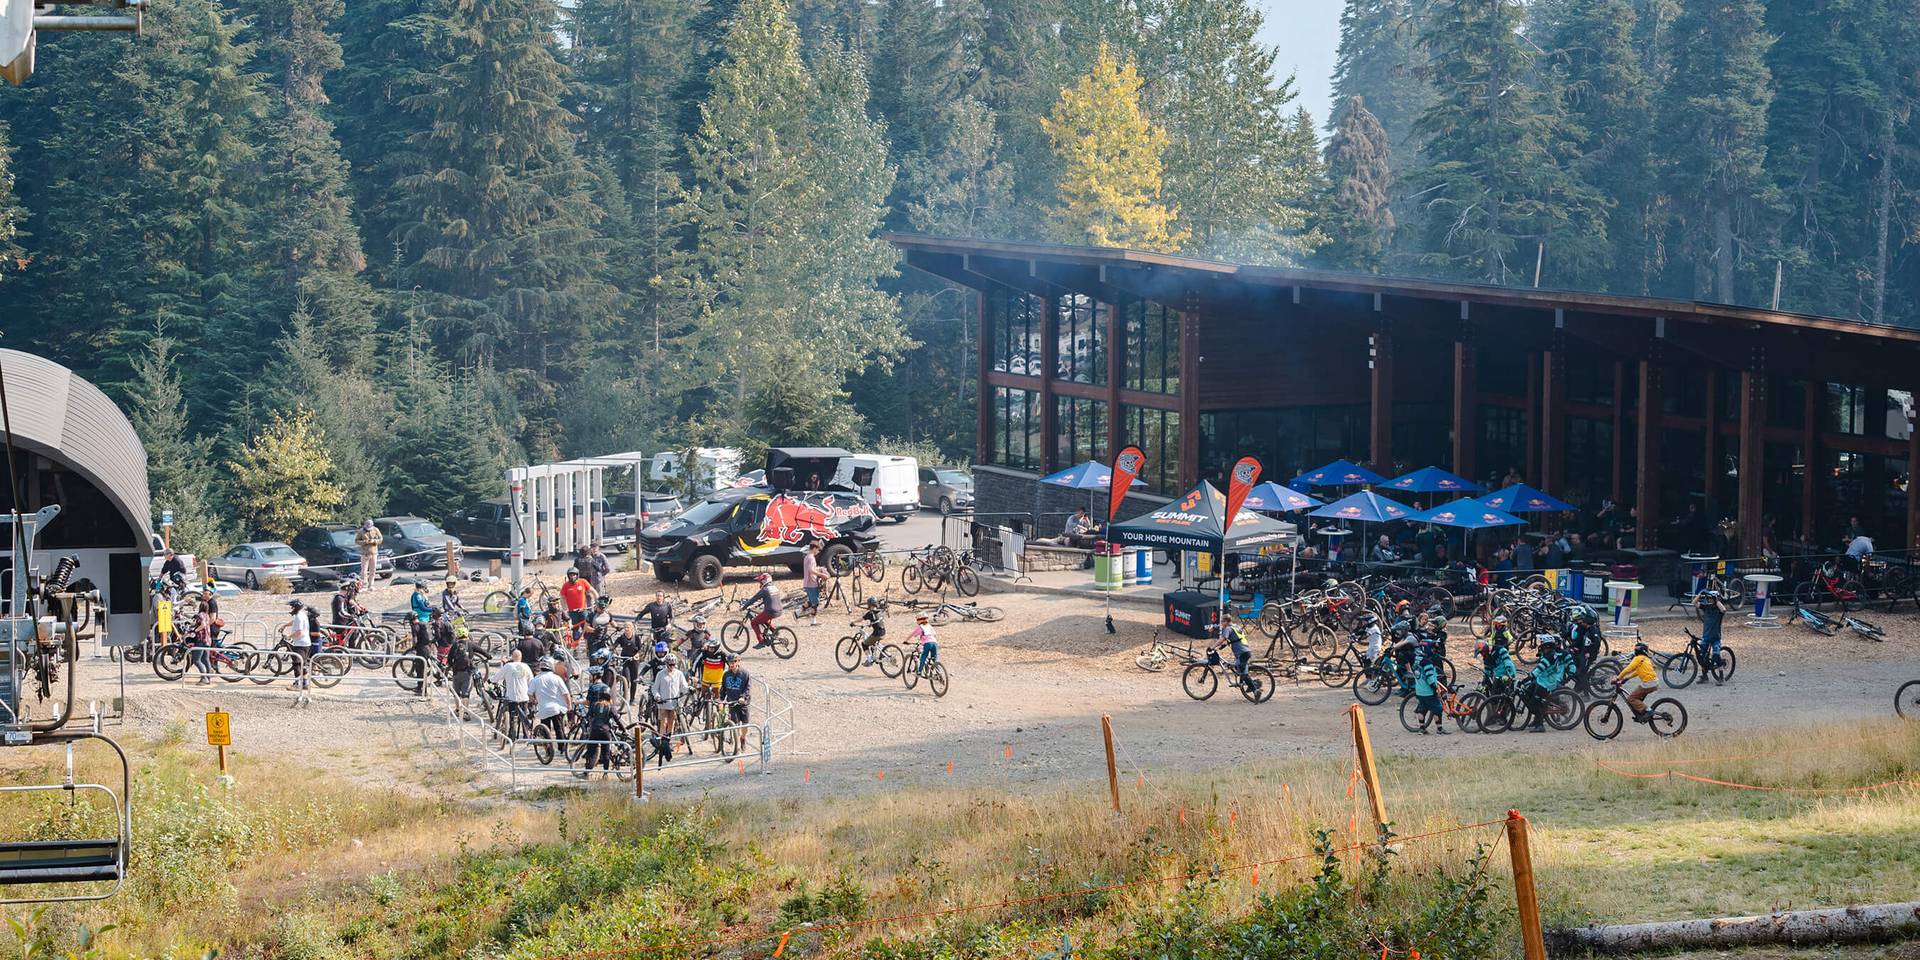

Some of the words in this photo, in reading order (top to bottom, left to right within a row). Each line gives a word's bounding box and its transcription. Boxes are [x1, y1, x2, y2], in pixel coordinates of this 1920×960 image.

[1151, 511, 1208, 523] SUMMIT
[1122, 532, 1144, 541] YOUR
[1145, 535, 1167, 543] HOME
[1169, 536, 1209, 547] MOUNTAIN
